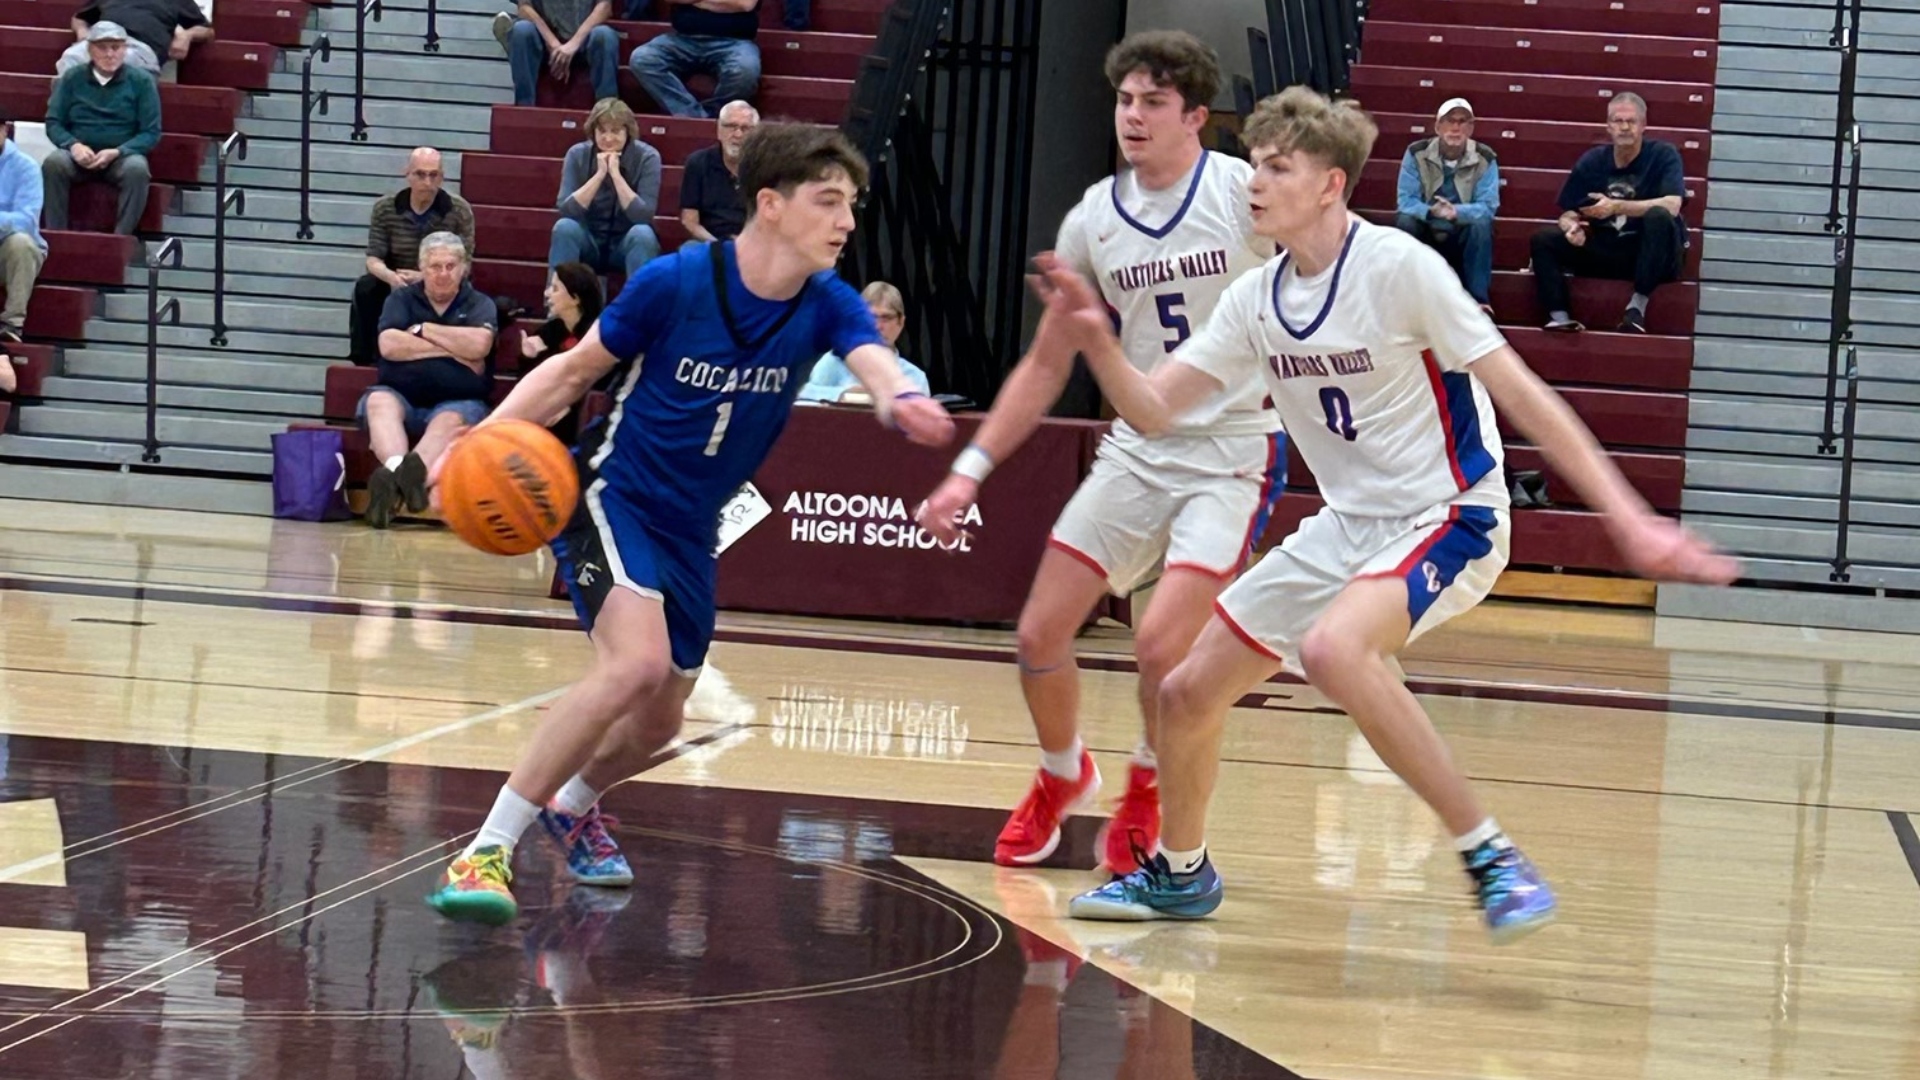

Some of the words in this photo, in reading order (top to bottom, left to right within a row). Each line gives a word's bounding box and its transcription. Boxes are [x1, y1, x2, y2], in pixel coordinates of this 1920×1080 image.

[1179, 249, 1228, 278] VALLEY
[1155, 292, 1191, 354] 5
[703, 401, 733, 457] 1
[1319, 386, 1358, 441] 0
[782, 491, 908, 520] ALTOONA
[790, 518, 856, 545] HIGH
